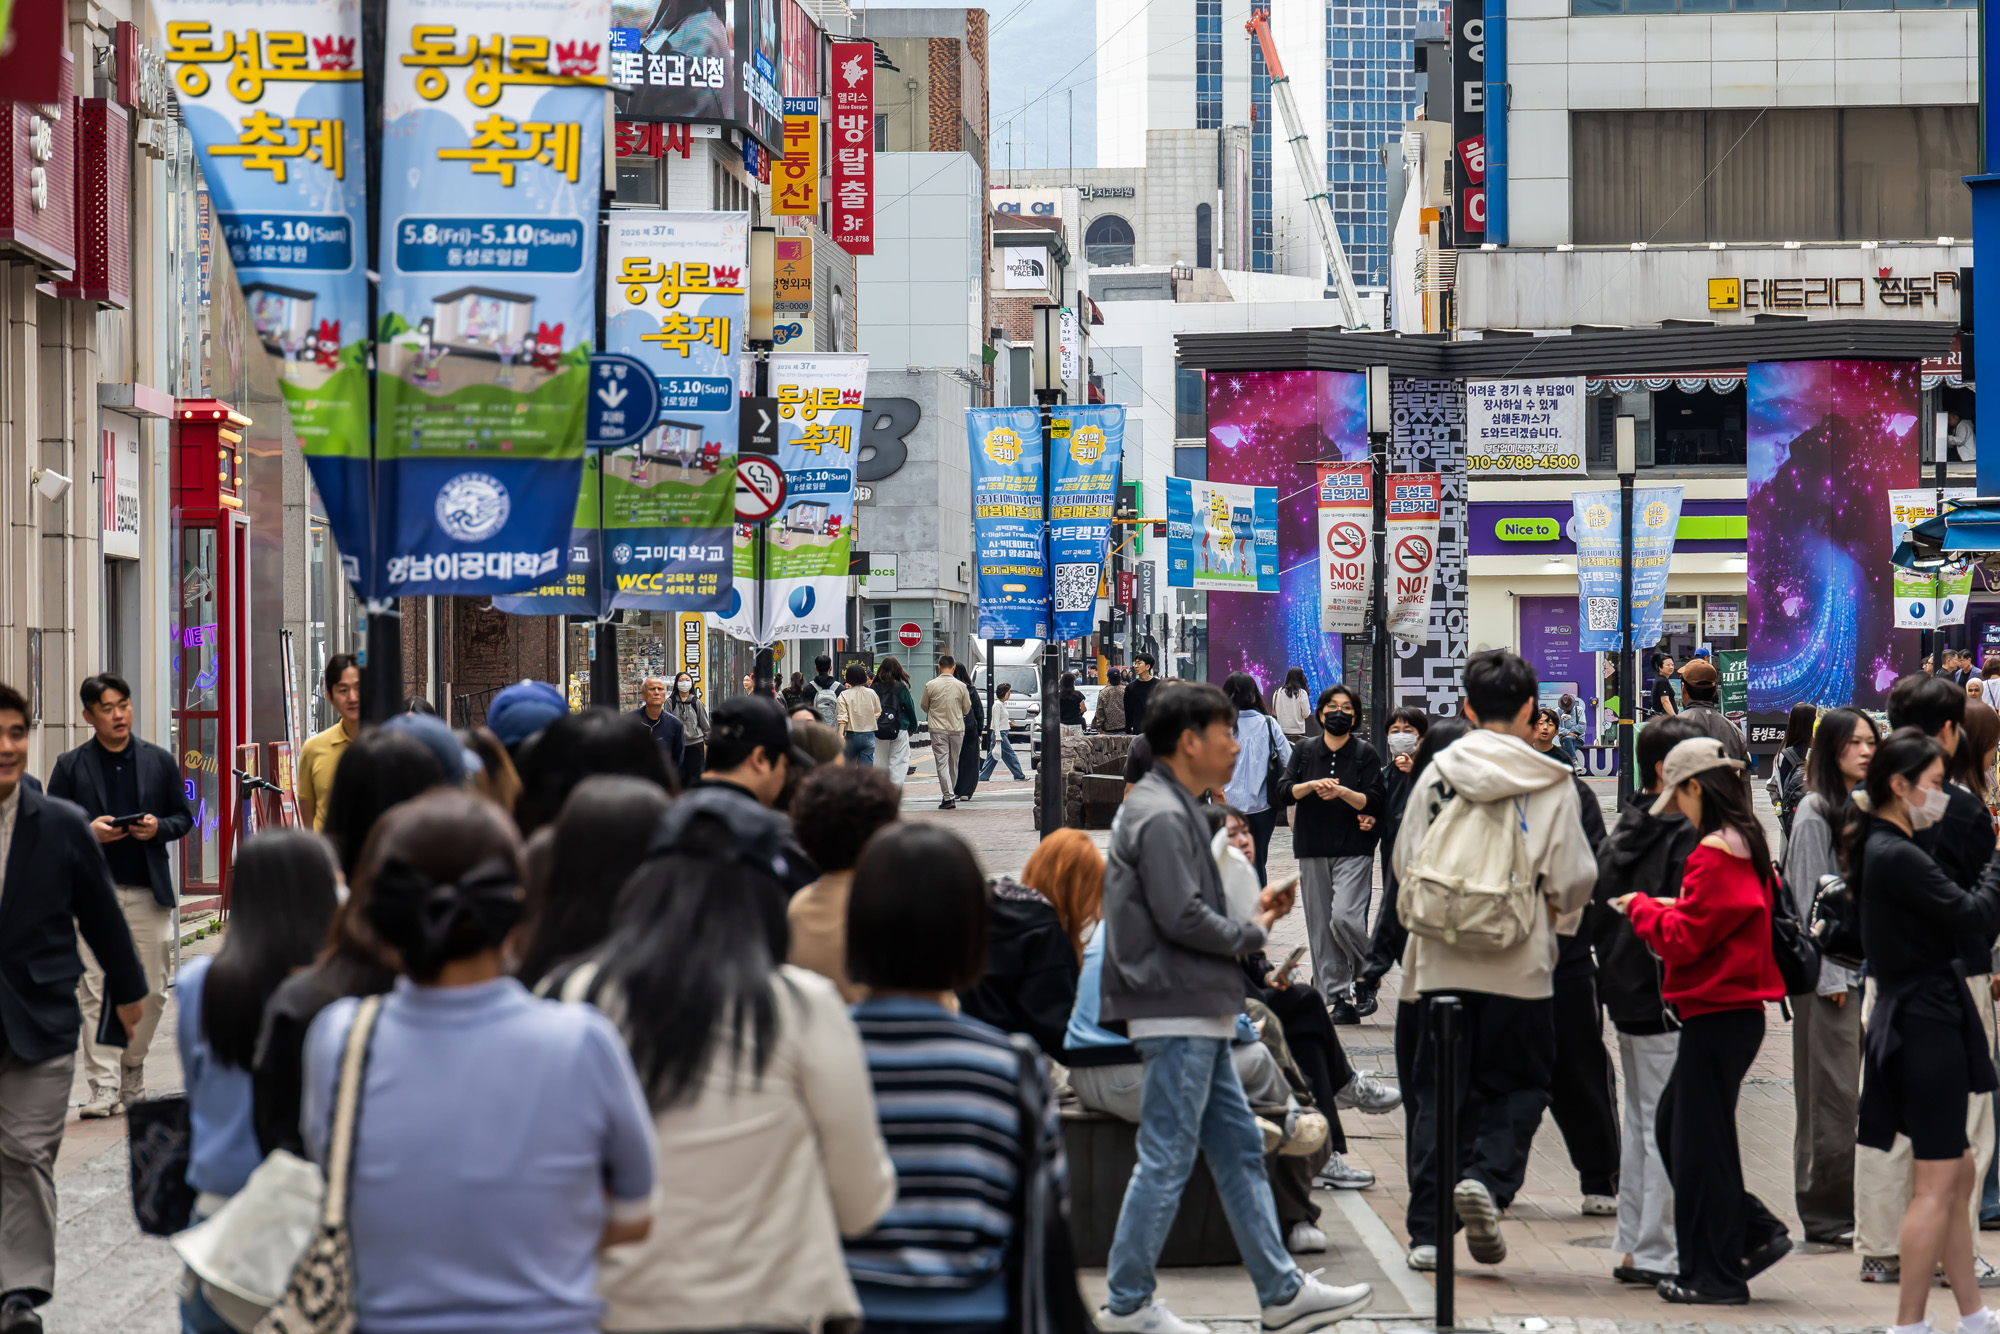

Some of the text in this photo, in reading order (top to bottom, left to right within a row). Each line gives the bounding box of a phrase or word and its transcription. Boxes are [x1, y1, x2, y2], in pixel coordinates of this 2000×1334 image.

[166, 21, 362, 103] 동성로
[401, 25, 607, 108] 동성로
[648, 54, 685, 86] 점검
[688, 56, 724, 89] 신청
[837, 92, 868, 104] 앨리스
[783, 100, 817, 112] 카데미
[706, 127, 716, 135] 3F
[208, 111, 345, 183] 축제
[437, 114, 581, 187] 축제
[780, 121, 813, 209] 부동산
[838, 115, 869, 209] 방탈출
[843, 214, 864, 231] 3F
[652, 225, 667, 236] 37
[1017, 258, 1032, 266] THE
[783, 263, 796, 277] 수
[616, 256, 745, 308] 동성로
[774, 302, 809, 310] 25-0009
[640, 311, 731, 358] 축제
[800, 362, 811, 370] 37
[1467, 384, 1575, 397] 어려운 경기 속 부담없이
[777, 384, 864, 421] 동성로
[1483, 398, 1559, 411] 장사하실 수 있게
[1491, 413, 1551, 425] 심해돈까스가
[789, 422, 852, 456] 축제
[1077, 433, 1100, 446] 전액
[1480, 427, 1562, 439] 도와드리겠습니다.
[992, 434, 1015, 447] 전액
[992, 447, 1015, 461] 국비
[1076, 447, 1099, 460] 국비
[1467, 454, 1580, 470] 010-6788-4500
[1325, 473, 1364, 488] 동성로
[1320, 487, 1371, 501] 금연거리
[1396, 485, 1433, 499] 동성로
[976, 505, 1043, 520] 채용예정자
[1051, 504, 1114, 519] 채용예정자
[1389, 499, 1439, 514] 금연거리
[1051, 526, 1107, 542] 부트캠프
[1505, 523, 1550, 535] Nice to
[634, 545, 725, 562] 구미대학교
[387, 547, 560, 584] 영남이공대학교
[1330, 563, 1365, 580] NO!
[616, 573, 664, 590] WCC
[666, 573, 718, 584] 교육부 선정
[1397, 576, 1428, 595] NO!
[665, 585, 717, 596] 세계적 대학
[1330, 581, 1365, 592] SMOKE
[1397, 595, 1426, 605] SMOKE
